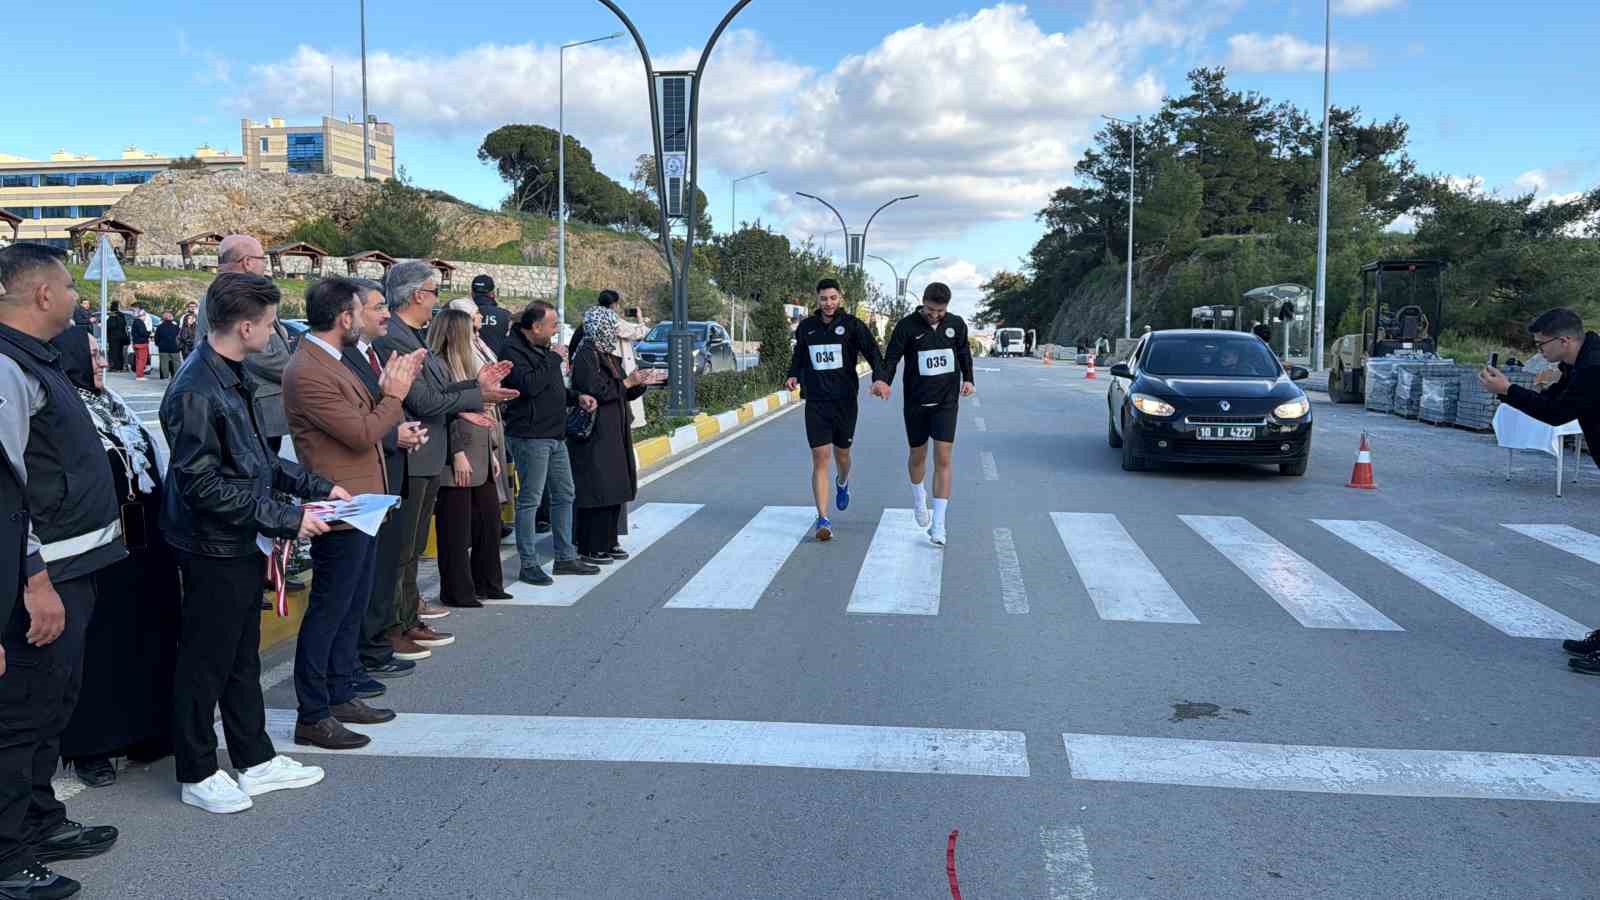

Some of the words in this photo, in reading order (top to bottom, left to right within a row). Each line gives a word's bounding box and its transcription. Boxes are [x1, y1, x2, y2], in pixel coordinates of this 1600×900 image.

[815, 351, 835, 363] 034
[926, 355, 947, 369] 035
[1201, 426, 1211, 437] 10
[1217, 426, 1224, 437] U
[1230, 427, 1252, 437] 4227
